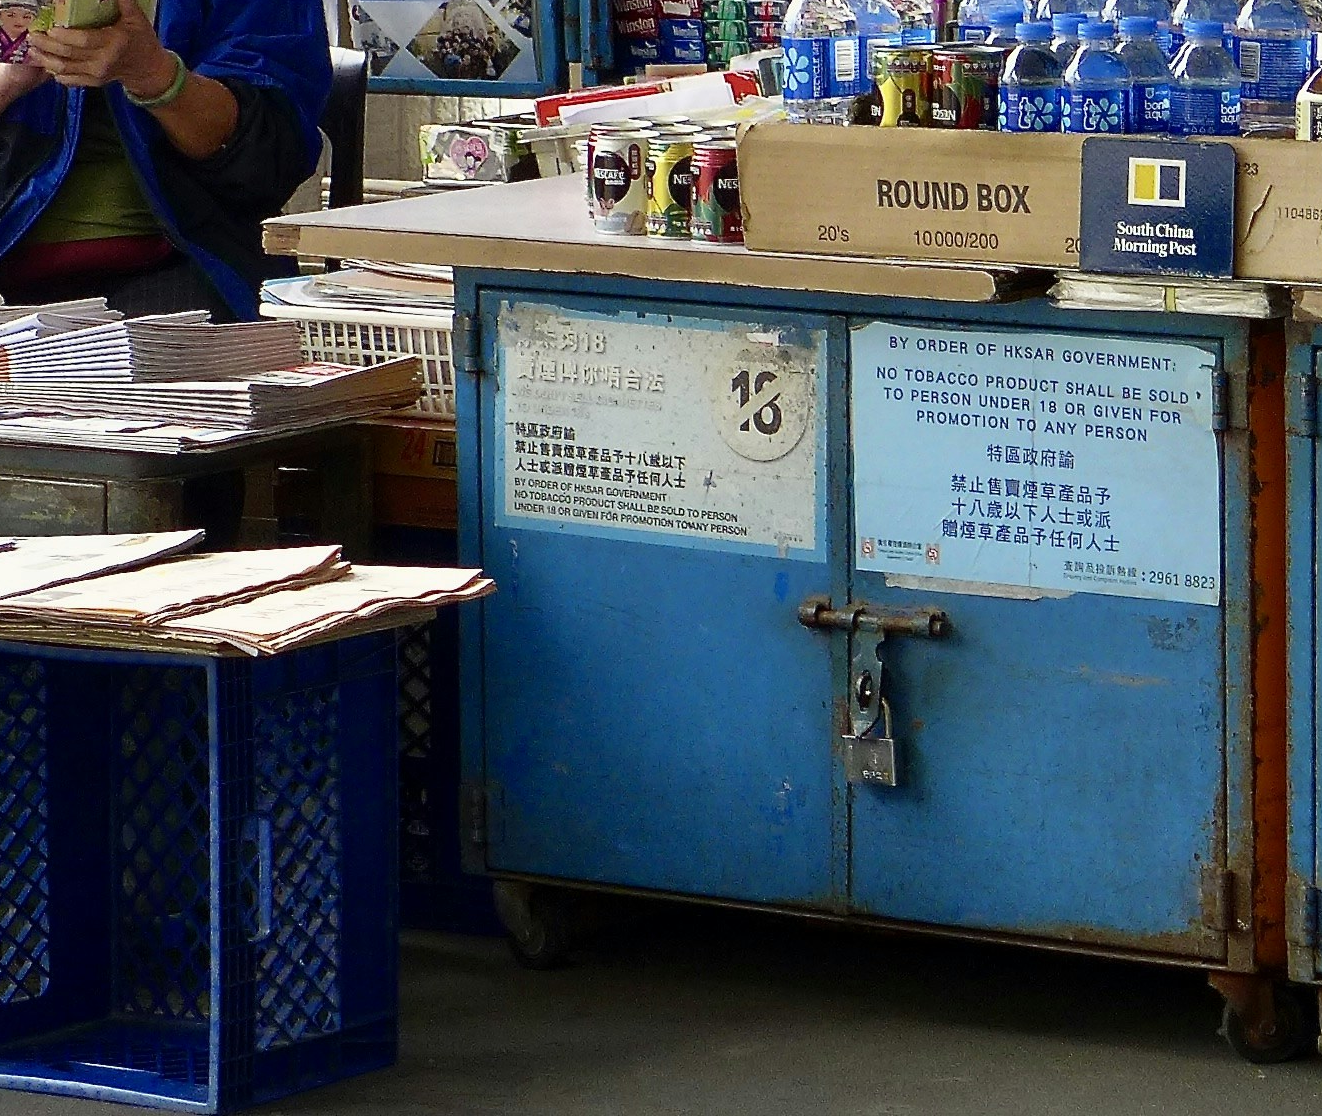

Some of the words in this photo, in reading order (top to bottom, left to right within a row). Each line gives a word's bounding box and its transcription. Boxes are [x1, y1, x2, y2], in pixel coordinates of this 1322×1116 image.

[618, 17, 656, 35] Winston
[877, 178, 969, 213] ROUND
[976, 181, 1031, 215] BOX
[817, 224, 850, 244] 20's
[1116, 220, 1153, 238] South
[1155, 222, 1194, 241] China
[1113, 237, 1167, 259] Morning
[1169, 240, 1197, 257] Post
[888, 335, 909, 350] BY
[916, 337, 968, 355] ORDER
[976, 342, 997, 356] OF
[1003, 344, 1054, 362] HKSAR
[876, 365, 897, 380] NO
[904, 368, 978, 387] TOBACCO
[985, 375, 1059, 393] PRODUCT
[1065, 381, 1115, 399] SHALL
[1121, 386, 1142, 401] BE
[1148, 389, 1190, 405] SOLD
[883, 386, 904, 401] TO
[910, 389, 971, 406] PERSON
[979, 395, 1030, 412] UNDER
[1039, 400, 1057, 414] 18
[1064, 402, 1086, 417] OR
[1093, 404, 1142, 422] GIVEN
[1149, 409, 1182, 425] FOR
[916, 409, 1009, 431] PROMOTION
[1016, 417, 1037, 433] TO
[1044, 421, 1077, 437] ANY
[1084, 423, 1148, 443] PERSON
[514, 477, 526, 488] BY
[528, 479, 559, 491] ORDER
[560, 481, 573, 492] OF
[574, 483, 604, 495] HKSAR
[950, 473, 1112, 506] 禁止售賣煙草產品予
[514, 489, 527, 500] NO
[529, 491, 572, 504] TOBACCO
[573, 495, 616, 509] PRODUCT
[617, 499, 646, 513] SHALL
[647, 503, 660, 514] BE
[660, 504, 684, 516] SOLD
[686, 507, 699, 518] TO
[701, 509, 738, 523] PERSON
[514, 501, 545, 514] UNDER
[557, 505, 571, 516] OR
[572, 507, 599, 520] GIVEN
[600, 510, 619, 522] FOR
[620, 512, 674, 528] PROMOTION
[710, 522, 748, 536] PERSON
[950, 496, 1112, 531] 十八歲以下人士或派
[940, 519, 1121, 553] 贈煙草產品予任何人士
[1184, 574, 1217, 591] 8823
